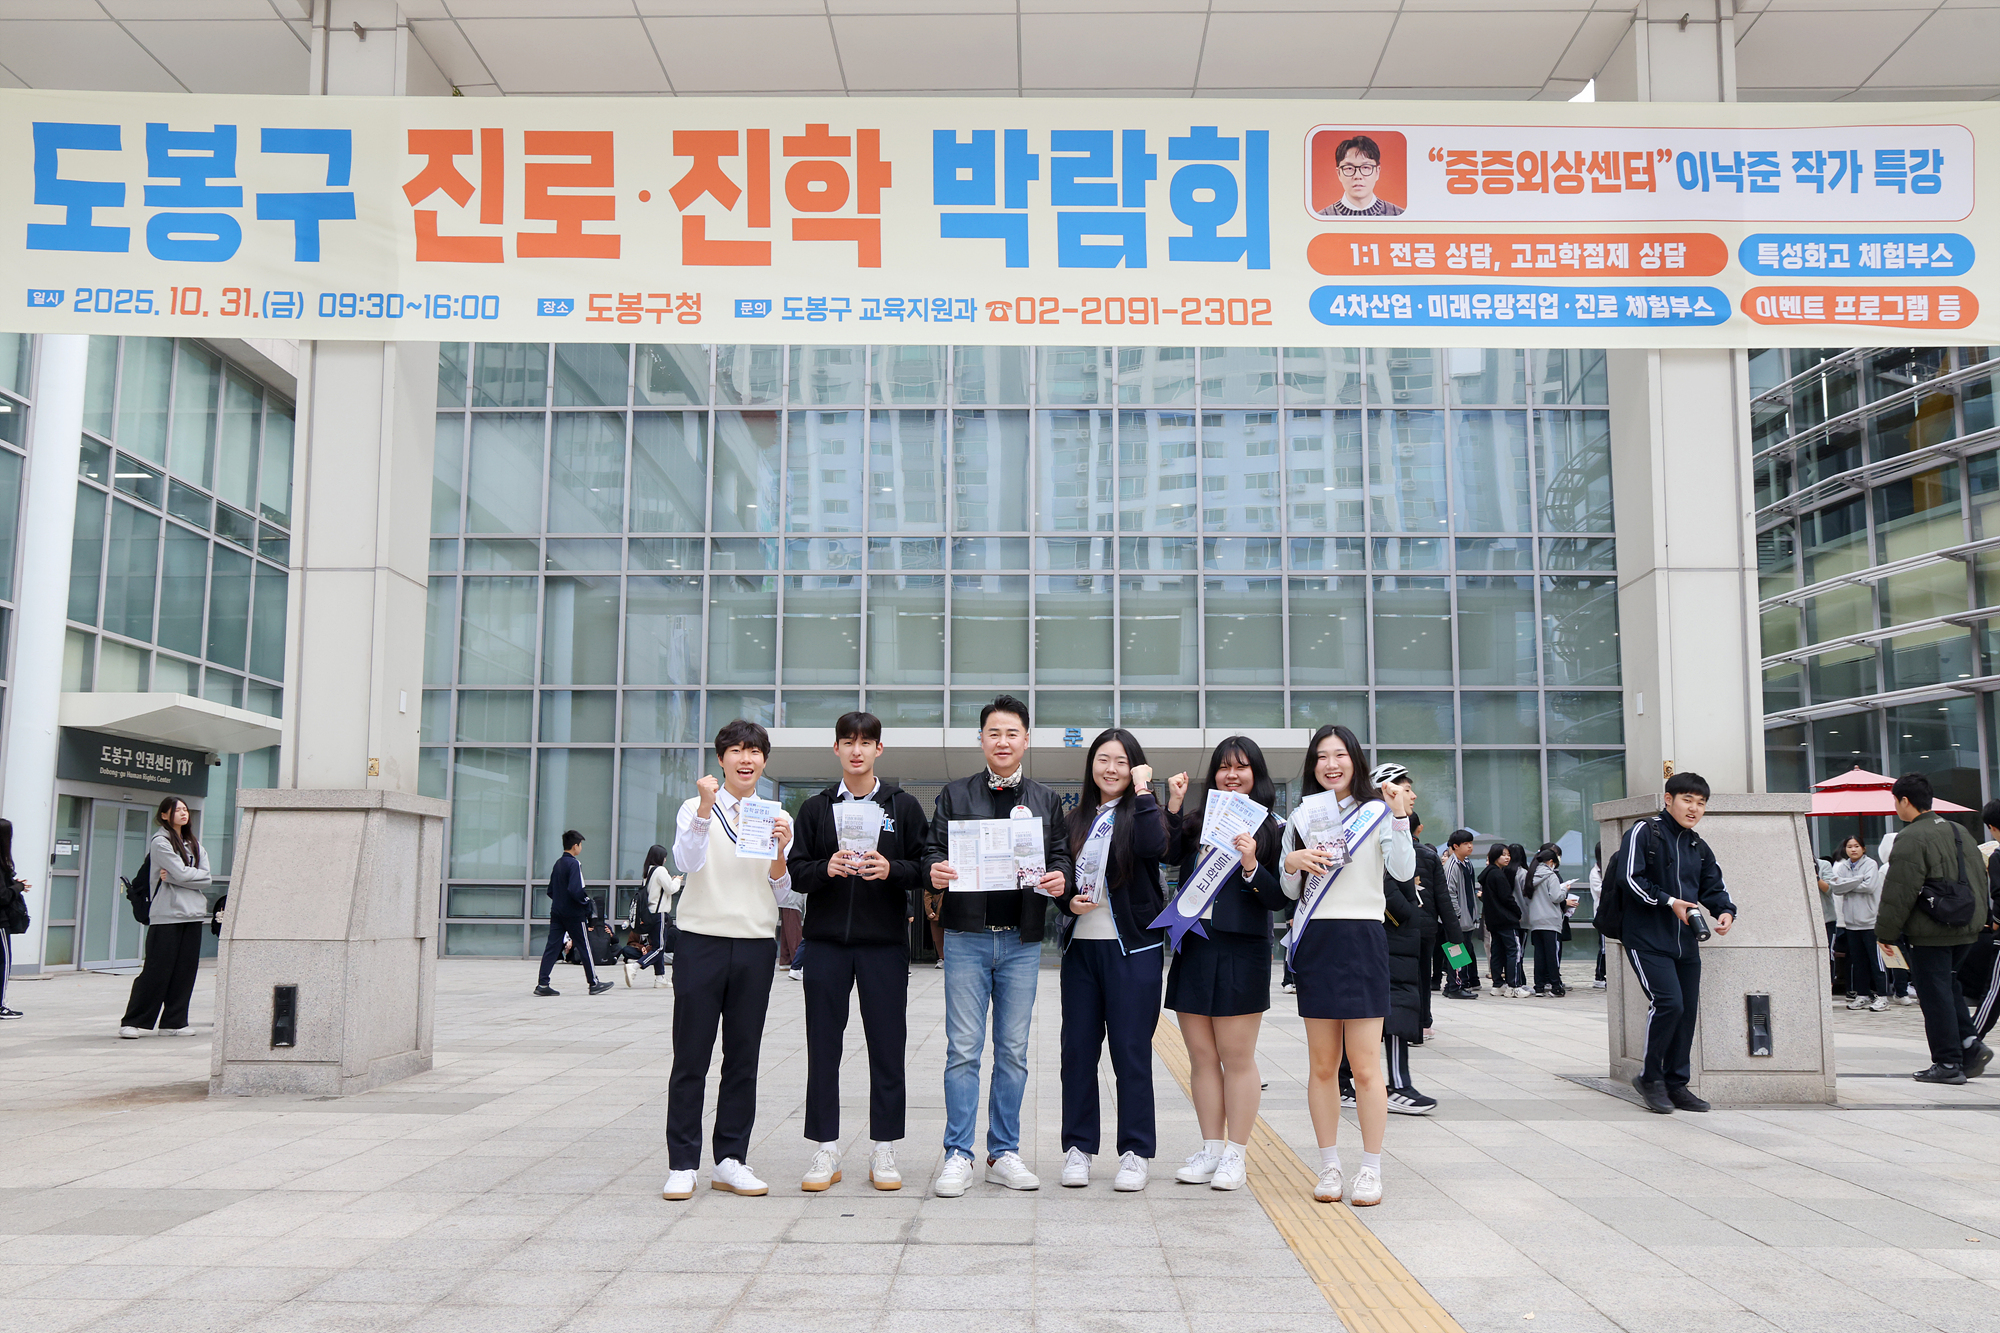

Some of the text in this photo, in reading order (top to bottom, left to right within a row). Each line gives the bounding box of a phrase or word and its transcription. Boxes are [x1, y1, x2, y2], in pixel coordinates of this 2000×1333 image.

[1792, 150, 1863, 193] 작가
[1875, 149, 1944, 194] 특강
[27, 122, 356, 262] 도봉구
[933, 126, 1270, 269] 박람회
[1351, 243, 1686, 271] 1:1 전공 상담, 고교학점제 상담
[1758, 243, 1953, 269] 특성화고 체험부스
[33, 291, 61, 306] 일시
[74, 288, 159, 315] 2025.
[171, 287, 208, 317] 10.
[319, 293, 499, 319] 09:30~16:00
[542, 300, 570, 315] 장소
[586, 292, 701, 324] 도봉구청
[740, 301, 768, 316] 문의
[782, 297, 1272, 325] 도봉구 교육지원과 02-2091-2302
[1626, 295, 1715, 318] 체험부스
[1756, 295, 1960, 322] 이벤트 프로그램 등
[100, 745, 174, 773] 도봉구 인권센터
